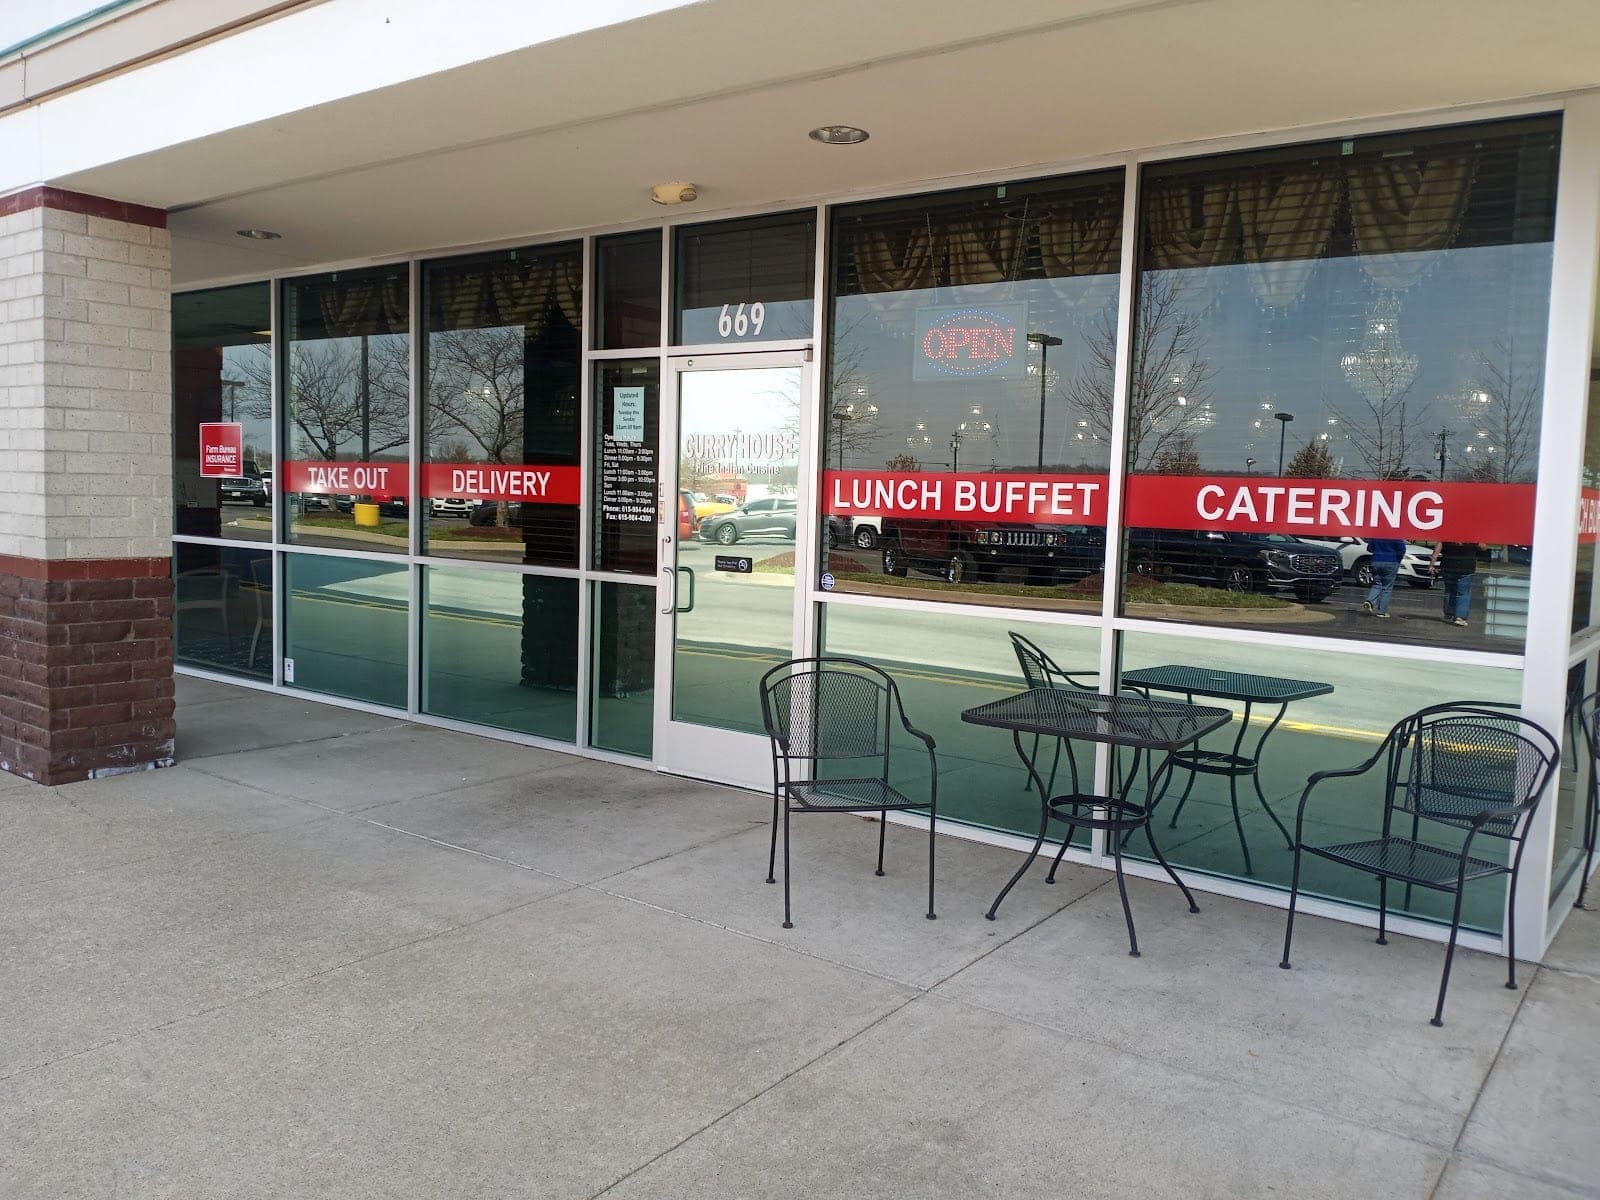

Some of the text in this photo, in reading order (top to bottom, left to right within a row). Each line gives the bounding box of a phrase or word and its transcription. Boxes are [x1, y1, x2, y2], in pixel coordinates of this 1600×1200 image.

[718, 301, 765, 338] 669
[923, 326, 1016, 359] OPEN
[205, 445, 237, 454] Farm Bureau
[205, 454, 237, 464] INSURANCE
[686, 433, 795, 460] CURRY HOUSE
[308, 467, 389, 490] TAKE OUT
[695, 462, 780, 475] Fine Indian Cuisine
[452, 469, 550, 496] DELIVERY
[602, 504, 620, 512] Phone:
[834, 478, 1100, 516] LUNCH BUFFET
[1196, 484, 1444, 530] CATERING
